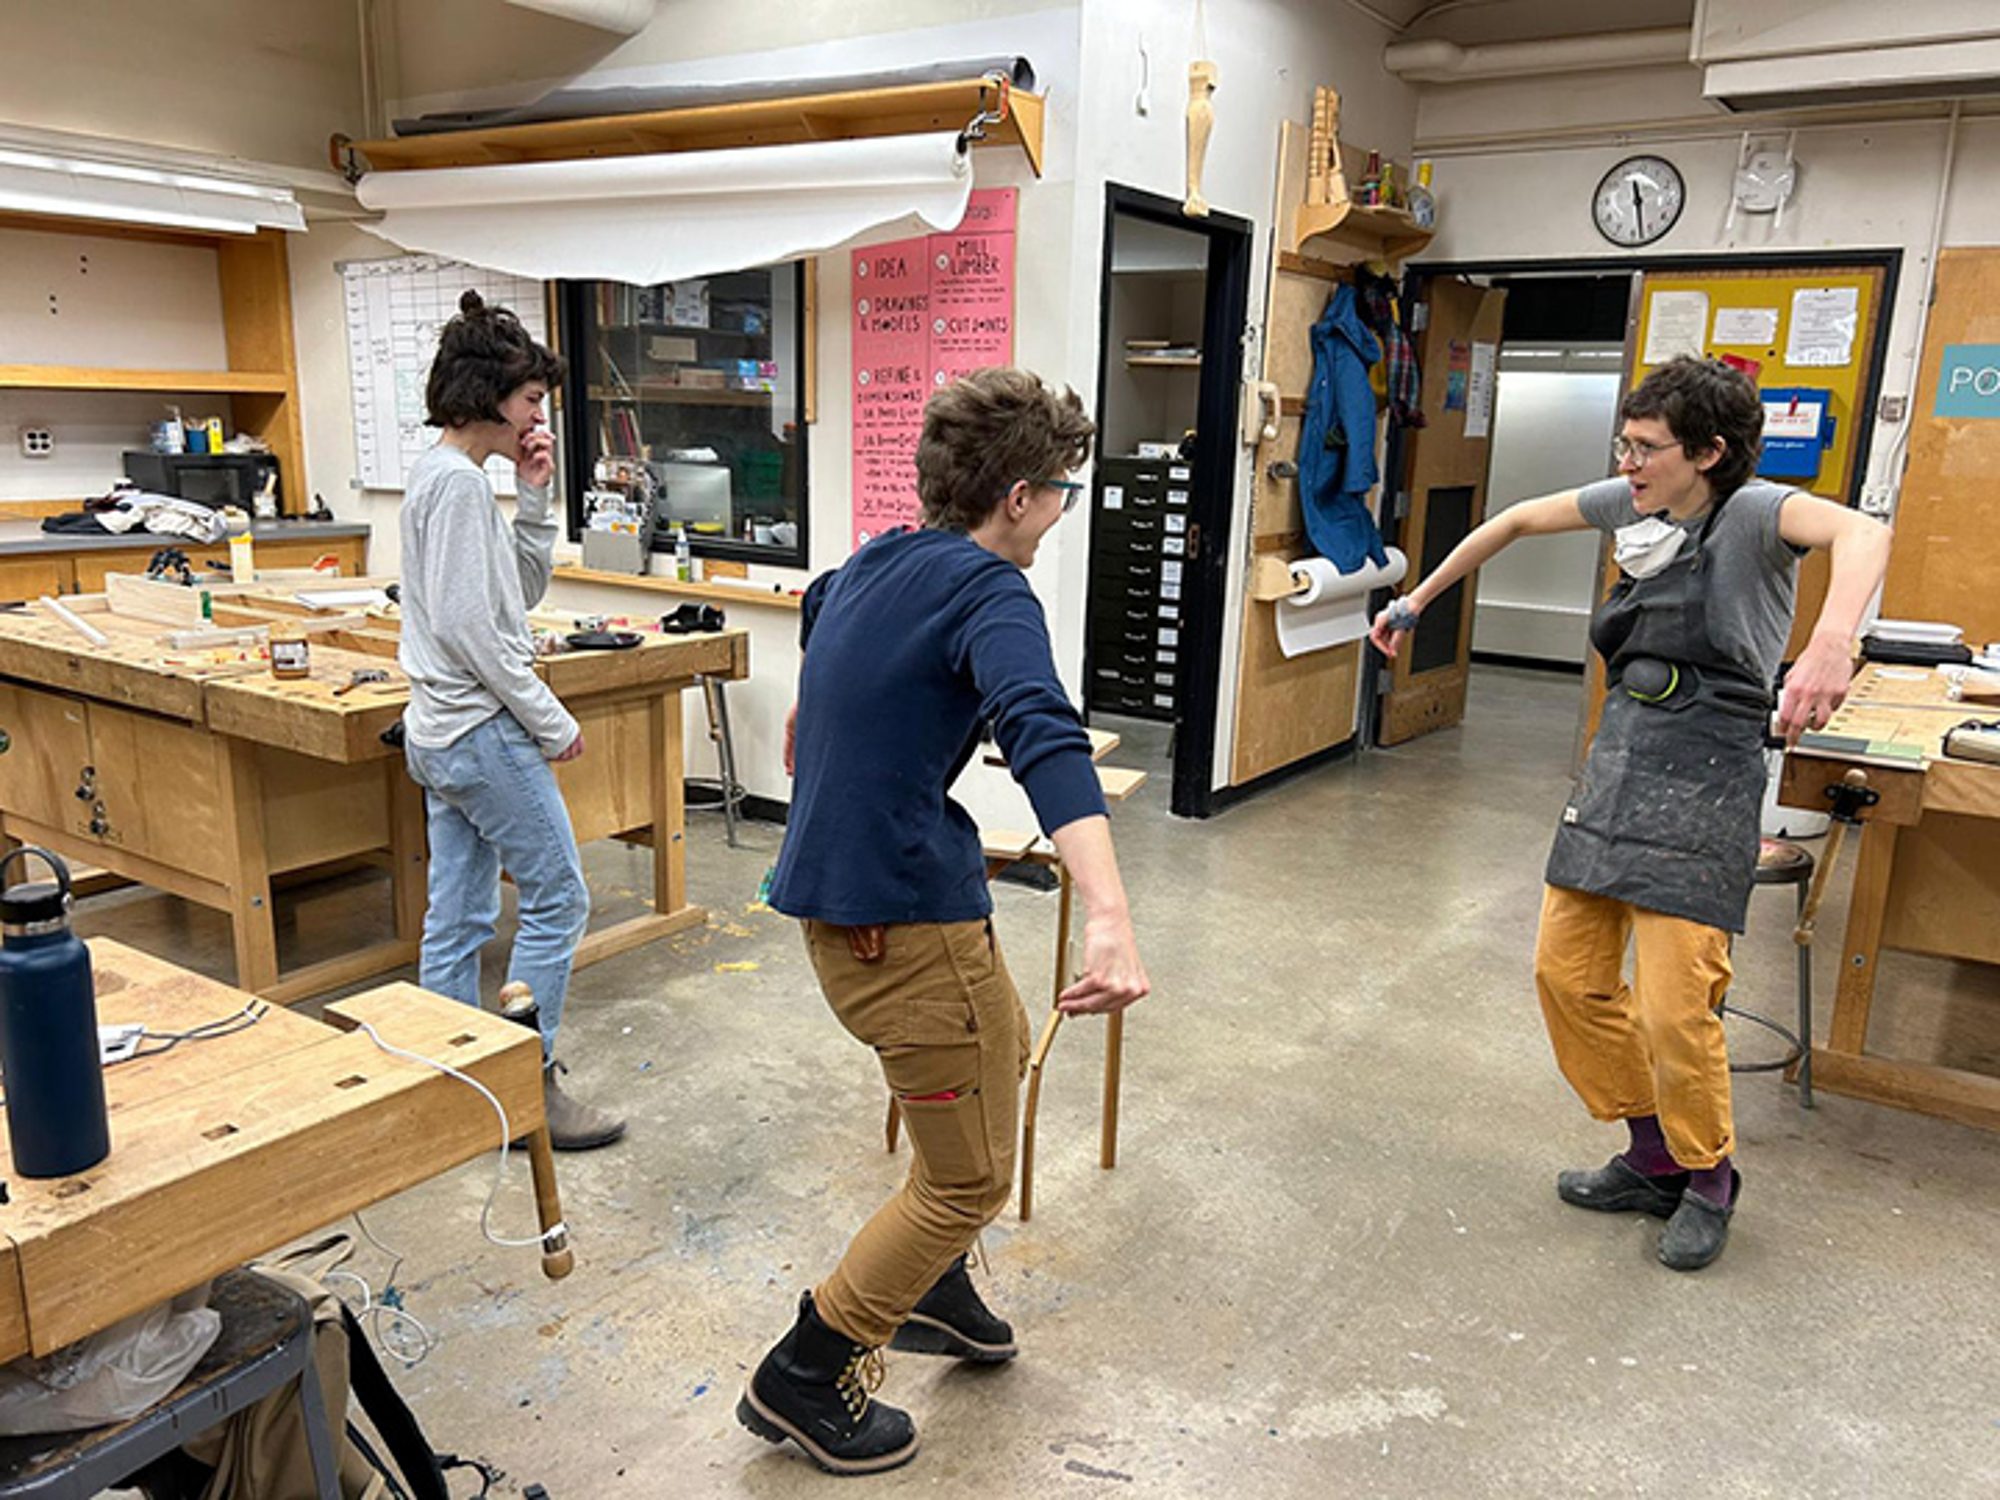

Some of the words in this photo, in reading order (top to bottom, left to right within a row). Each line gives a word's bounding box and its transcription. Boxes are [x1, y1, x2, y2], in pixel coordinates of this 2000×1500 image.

[955, 239, 988, 257] MILL
[873, 257, 908, 279] IDEA
[950, 253, 1001, 276] LUMBER
[873, 294, 929, 314] DRAWINGS
[871, 314, 921, 333] MODELS
[949, 317, 971, 334] CUT
